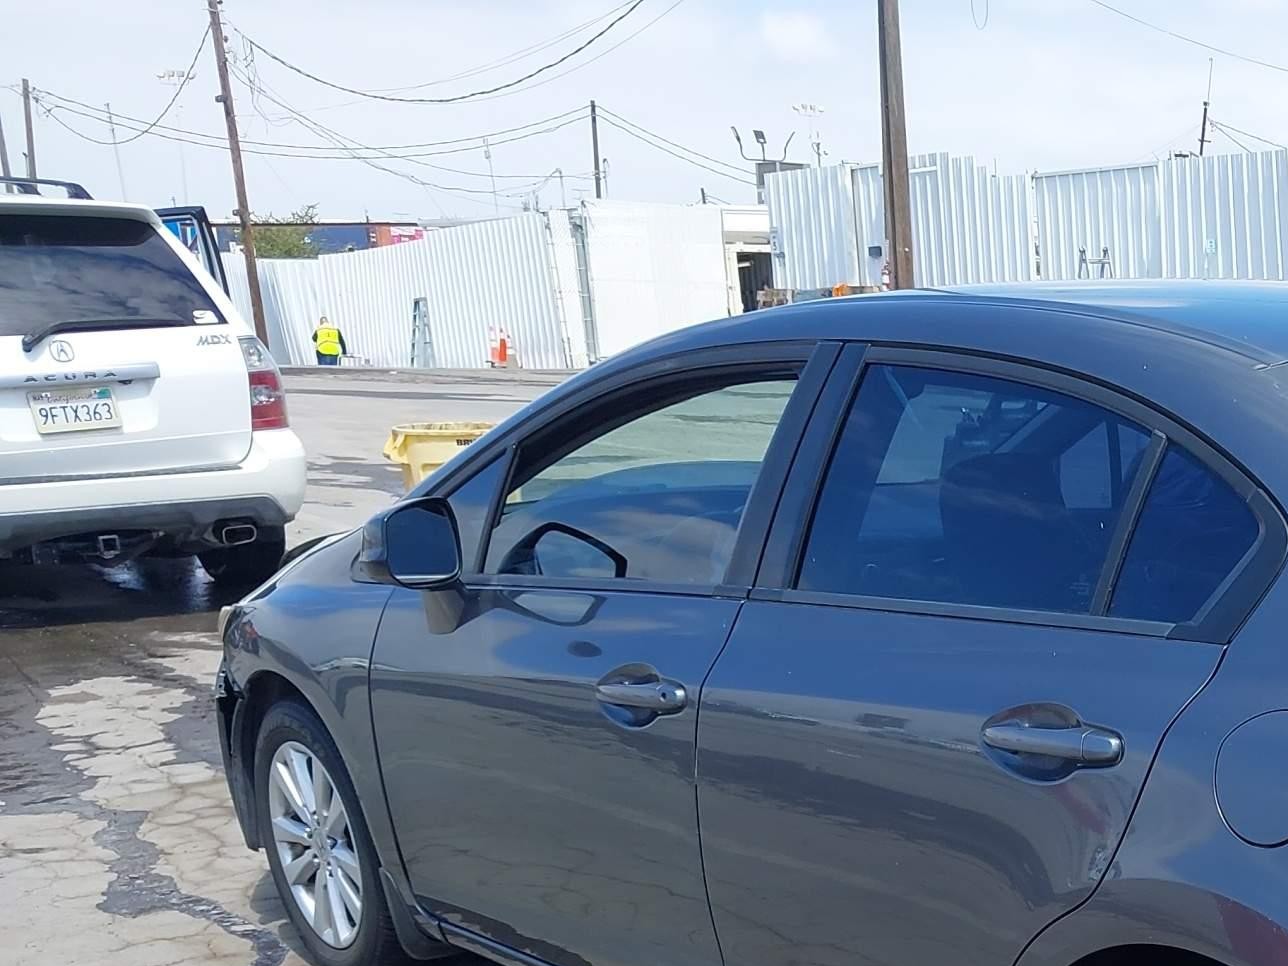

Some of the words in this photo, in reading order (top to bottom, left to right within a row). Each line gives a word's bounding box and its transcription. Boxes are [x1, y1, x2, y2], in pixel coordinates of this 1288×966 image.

[196, 334, 232, 346] MDX
[24, 371, 117, 383] ACURA
[38, 402, 113, 425] 9FTX363
